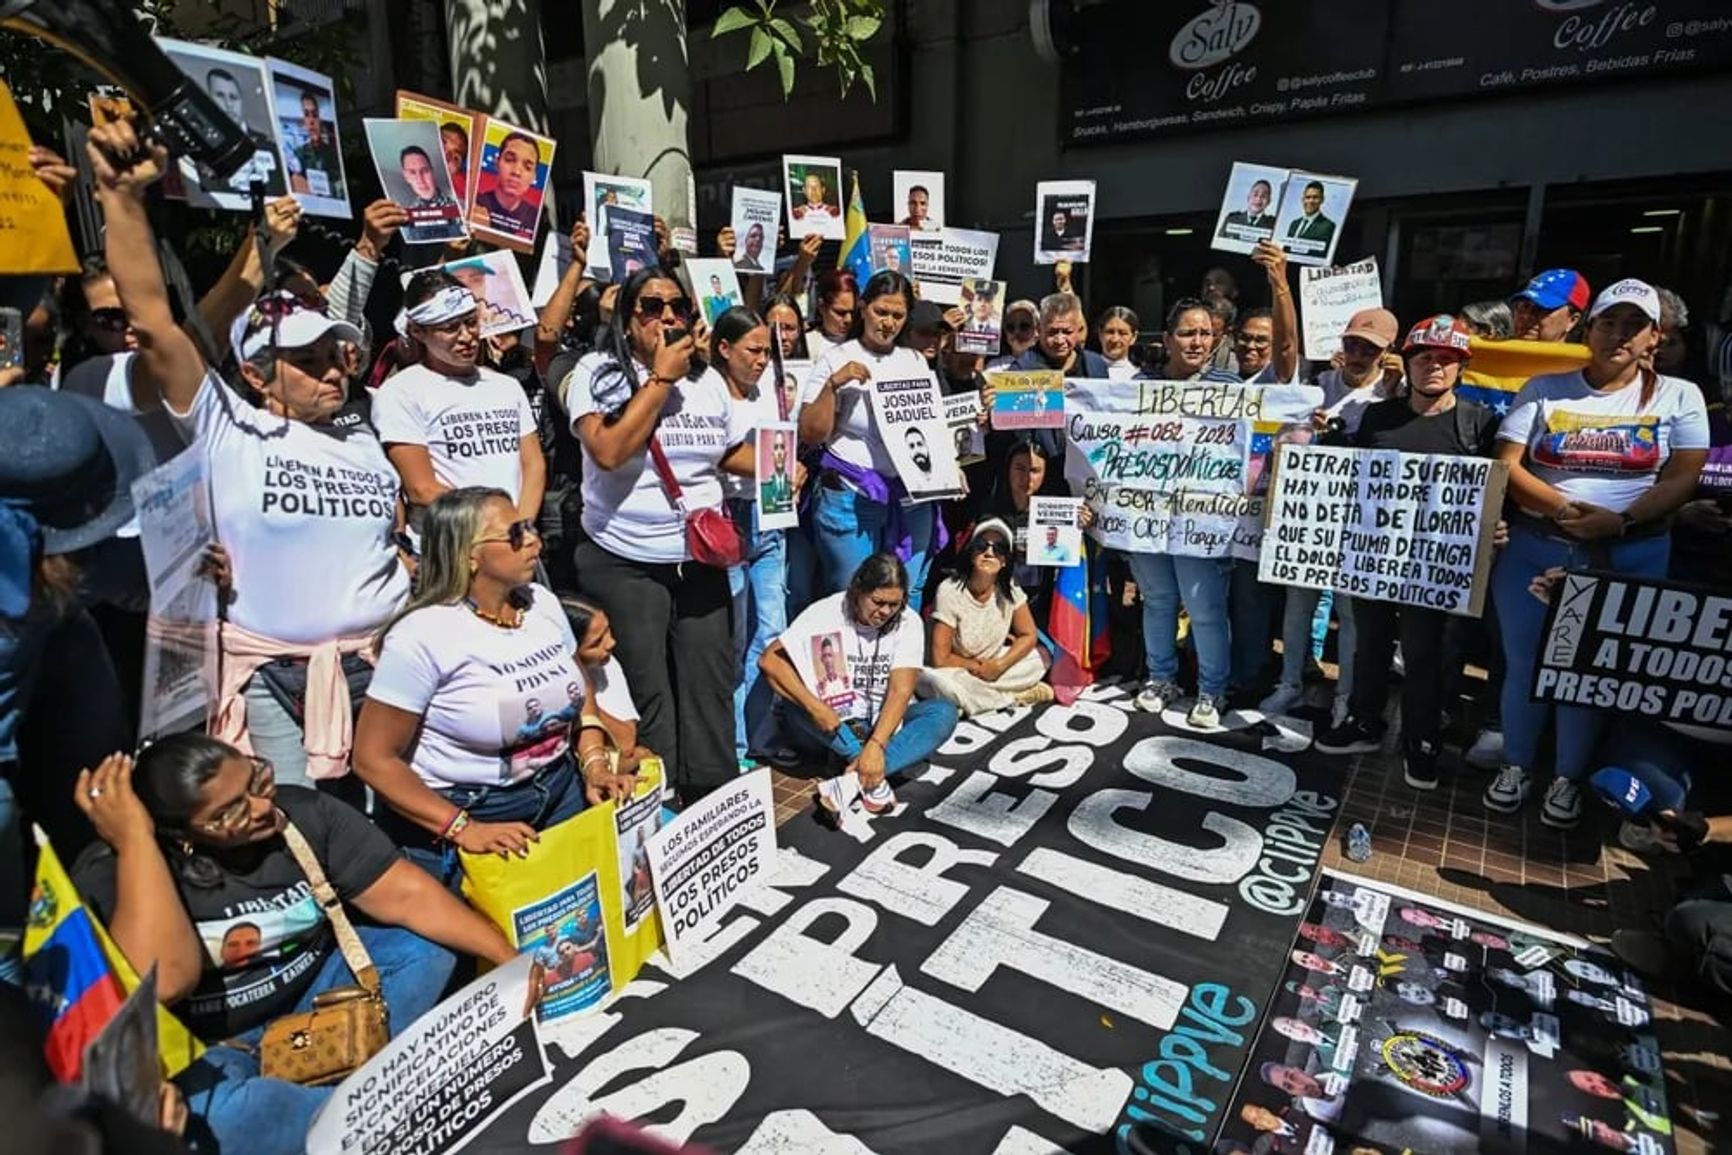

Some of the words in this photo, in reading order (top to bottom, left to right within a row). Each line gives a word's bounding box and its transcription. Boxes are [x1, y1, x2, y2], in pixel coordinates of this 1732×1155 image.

[1554, 2, 1657, 52] Coffee
[1685, 20, 1732, 36] @saly
[1186, 62, 1257, 103] Coffee
[1521, 64, 1579, 83] Postres,
[1586, 55, 1649, 73] Bebidas
[1192, 105, 1247, 122] Sandwich,
[945, 246, 971, 254] TODOS
[973, 248, 989, 256] LOS
[1307, 262, 1375, 282] LIBERTAD
[882, 391, 934, 409] JOSNAR
[885, 407, 937, 424] BADUEL
[440, 411, 483, 426] LIBEREN
[484, 411, 492, 421] A
[443, 424, 475, 441] LOS
[477, 420, 520, 438] PRESO
[447, 436, 519, 459] POLÍTICO
[1286, 451, 1361, 478] DETRAS
[1369, 459, 1393, 479] DE
[264, 470, 308, 490] LOS
[326, 467, 337, 478] A
[337, 469, 383, 486] TODOS
[1283, 478, 1320, 496] HAY
[1327, 480, 1359, 498] UNA
[1367, 482, 1432, 502] MADRE
[1441, 486, 1481, 506] QUE
[262, 491, 394, 520] POLÍTICOS
[1036, 510, 1074, 519] VERNET
[1281, 501, 1308, 520] NO
[1316, 503, 1362, 526] DEJA
[1375, 508, 1407, 529] DE
[1413, 509, 1477, 537] LLORAR
[1277, 523, 1308, 545] QUE
[1313, 527, 1336, 548] SU
[1339, 529, 1391, 556] PLUMA
[1395, 536, 1472, 567] DETENGA
[1274, 545, 1293, 563] EL
[1297, 547, 1346, 570] DOLOR
[1427, 564, 1473, 589] TODOS
[1271, 562, 1298, 580] LOS
[1304, 566, 1370, 591] PRESOS
[1374, 582, 1462, 610] POLITICOS
[1551, 576, 1600, 664] YARE
[1597, 580, 1732, 651] LIBE
[1592, 637, 1620, 670] A
[515, 664, 569, 693] PDVSA
[1535, 667, 1667, 716] PRESOS
[1669, 689, 1732, 727] POL
[659, 838, 700, 875] SEGUIMOS
[699, 804, 748, 843] ESPERANDO
[748, 798, 762, 811] LA
[662, 832, 683, 857] LOS
[684, 789, 750, 841] FAMILIARES
[664, 850, 713, 892] LIBERTAD
[711, 838, 728, 854] DE
[726, 814, 765, 844] TODOS
[668, 882, 698, 918] LOS
[700, 836, 760, 890] PRESOS
[519, 900, 559, 926] LIBERTAD
[673, 856, 761, 941] POLÍTICOS
[344, 1014, 474, 1129] SIGNIFICATIVO
[476, 994, 501, 1019] DE
[346, 1076, 378, 1107] NO
[382, 1039, 419, 1076] HAY
[422, 981, 498, 1045] NÚMERO
[340, 1006, 508, 1152] EXCARCELACIONES
[360, 1128, 388, 1152] EN
[391, 1038, 491, 1127] VENEZUELA
[394, 1117, 414, 1138] SÍ
[413, 1096, 442, 1122] UN
[442, 1033, 517, 1100] NÚMERO
[438, 1097, 463, 1122] DE
[463, 1046, 524, 1102] PRESOS
